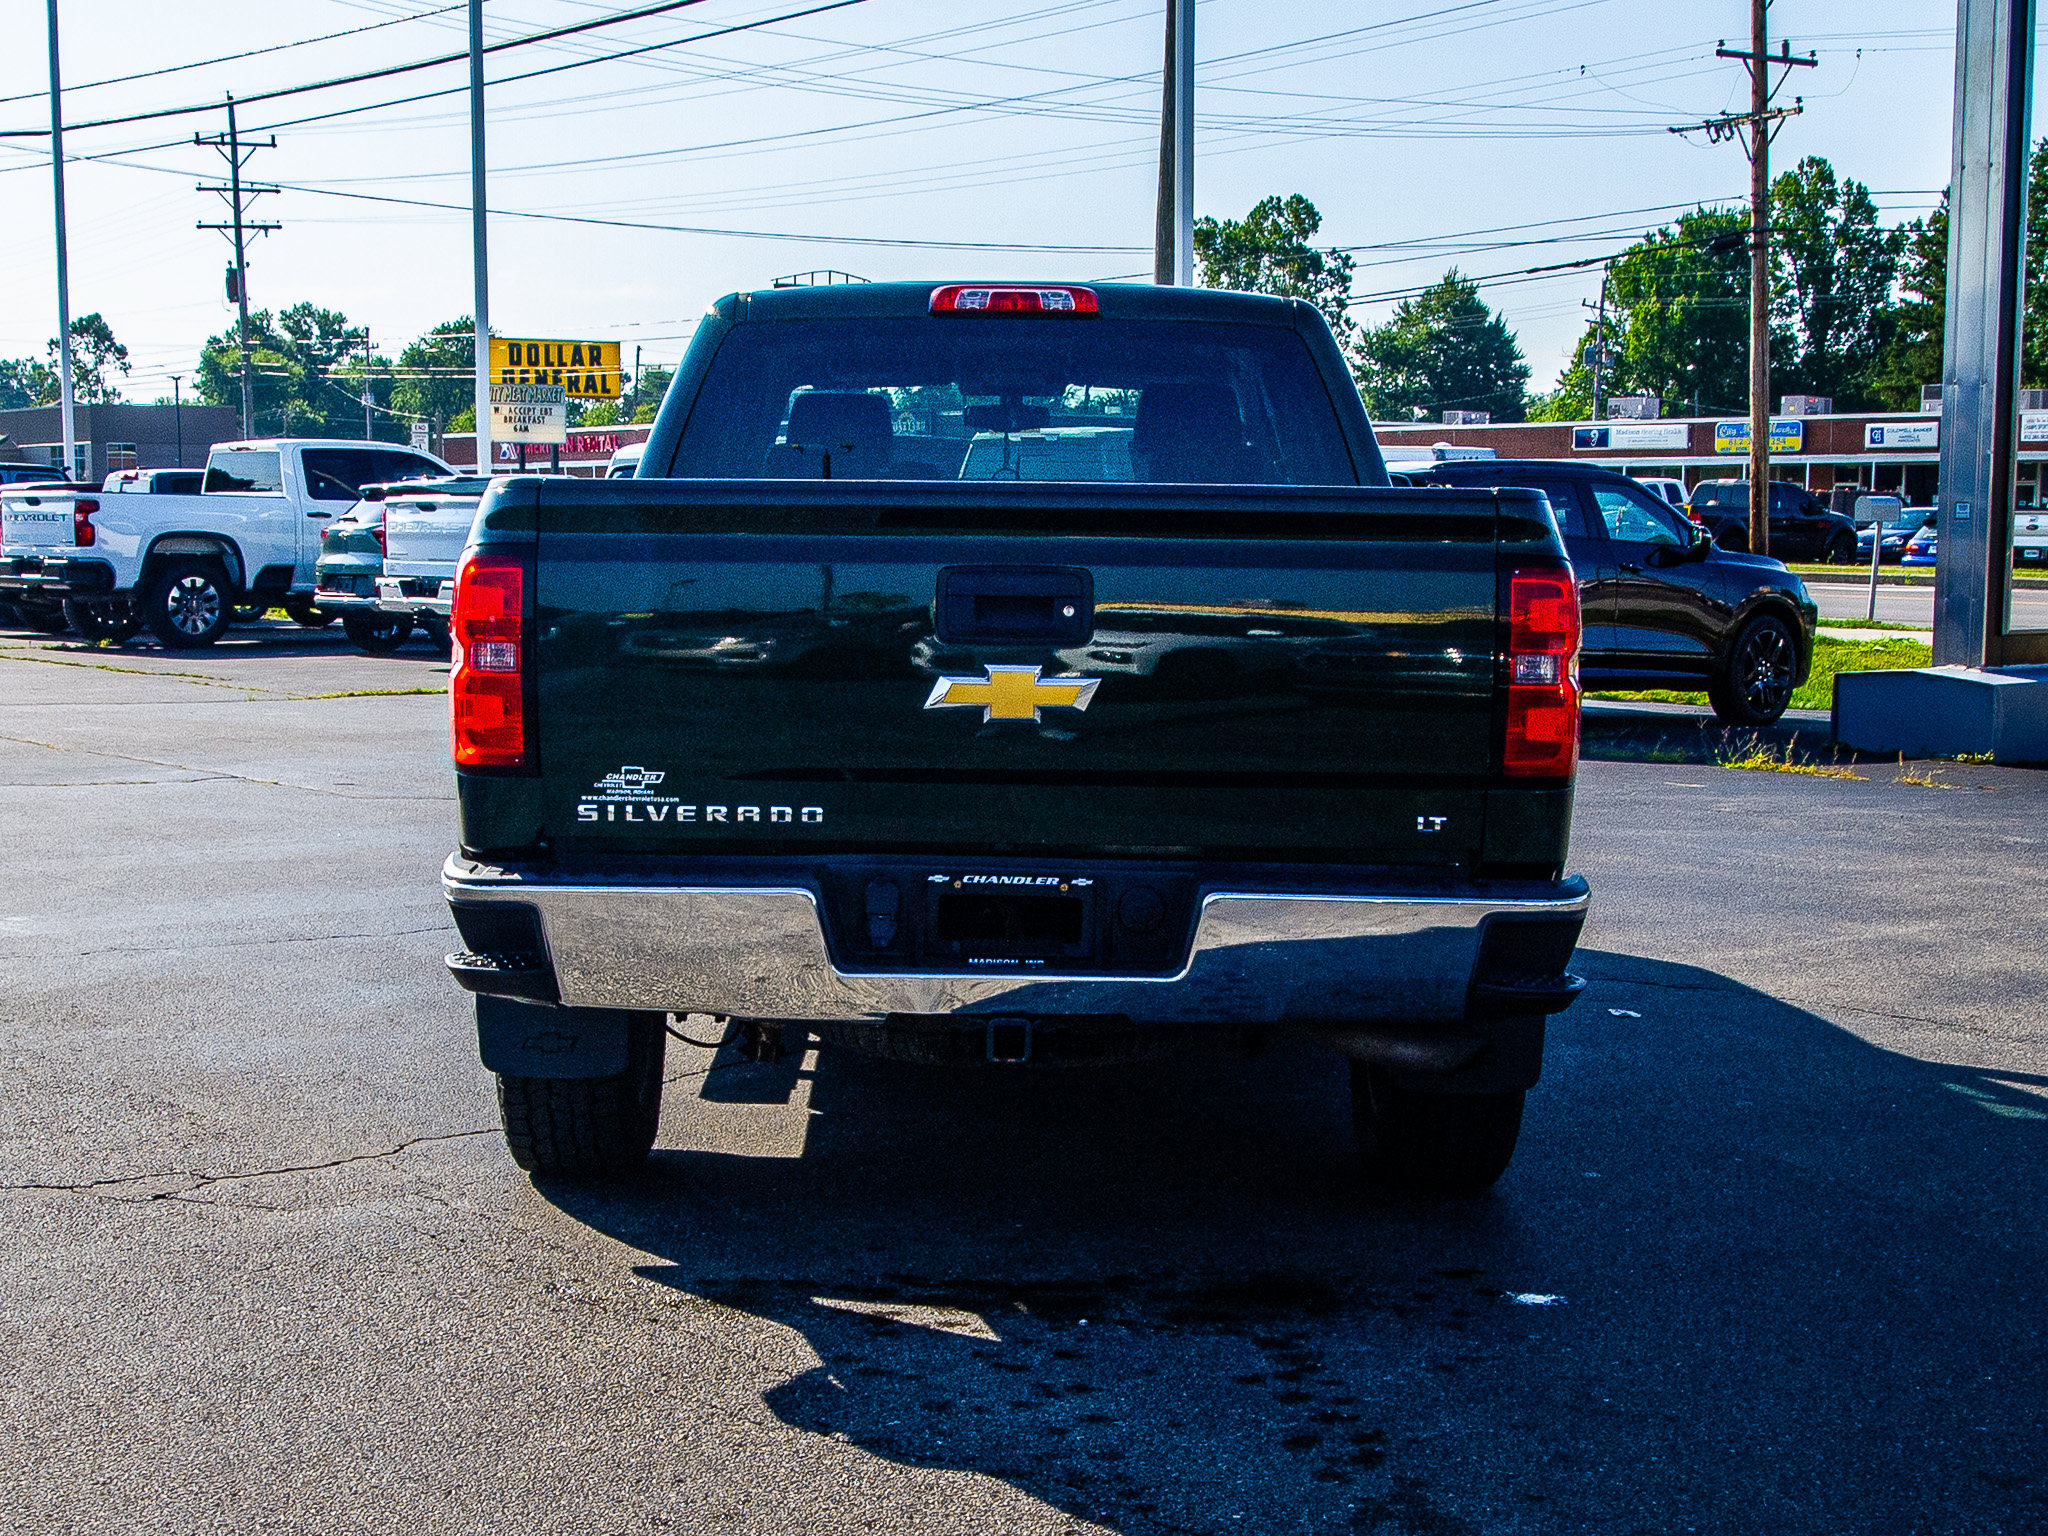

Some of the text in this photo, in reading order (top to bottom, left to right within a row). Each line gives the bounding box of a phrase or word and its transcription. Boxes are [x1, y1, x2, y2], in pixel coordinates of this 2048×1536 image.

[508, 342, 602, 367] DOLLAR
[490, 386, 564, 404] ITY MEAT MARKET
[509, 406, 536, 416] ACCEPT
[503, 415, 546, 424] BREAKFAST
[513, 424, 530, 433] 6AM
[606, 773, 657, 781] CHANDLER
[577, 804, 824, 823] SILVERADO
[1417, 816, 1448, 832] LT
[962, 875, 1060, 886] CHANDLER
